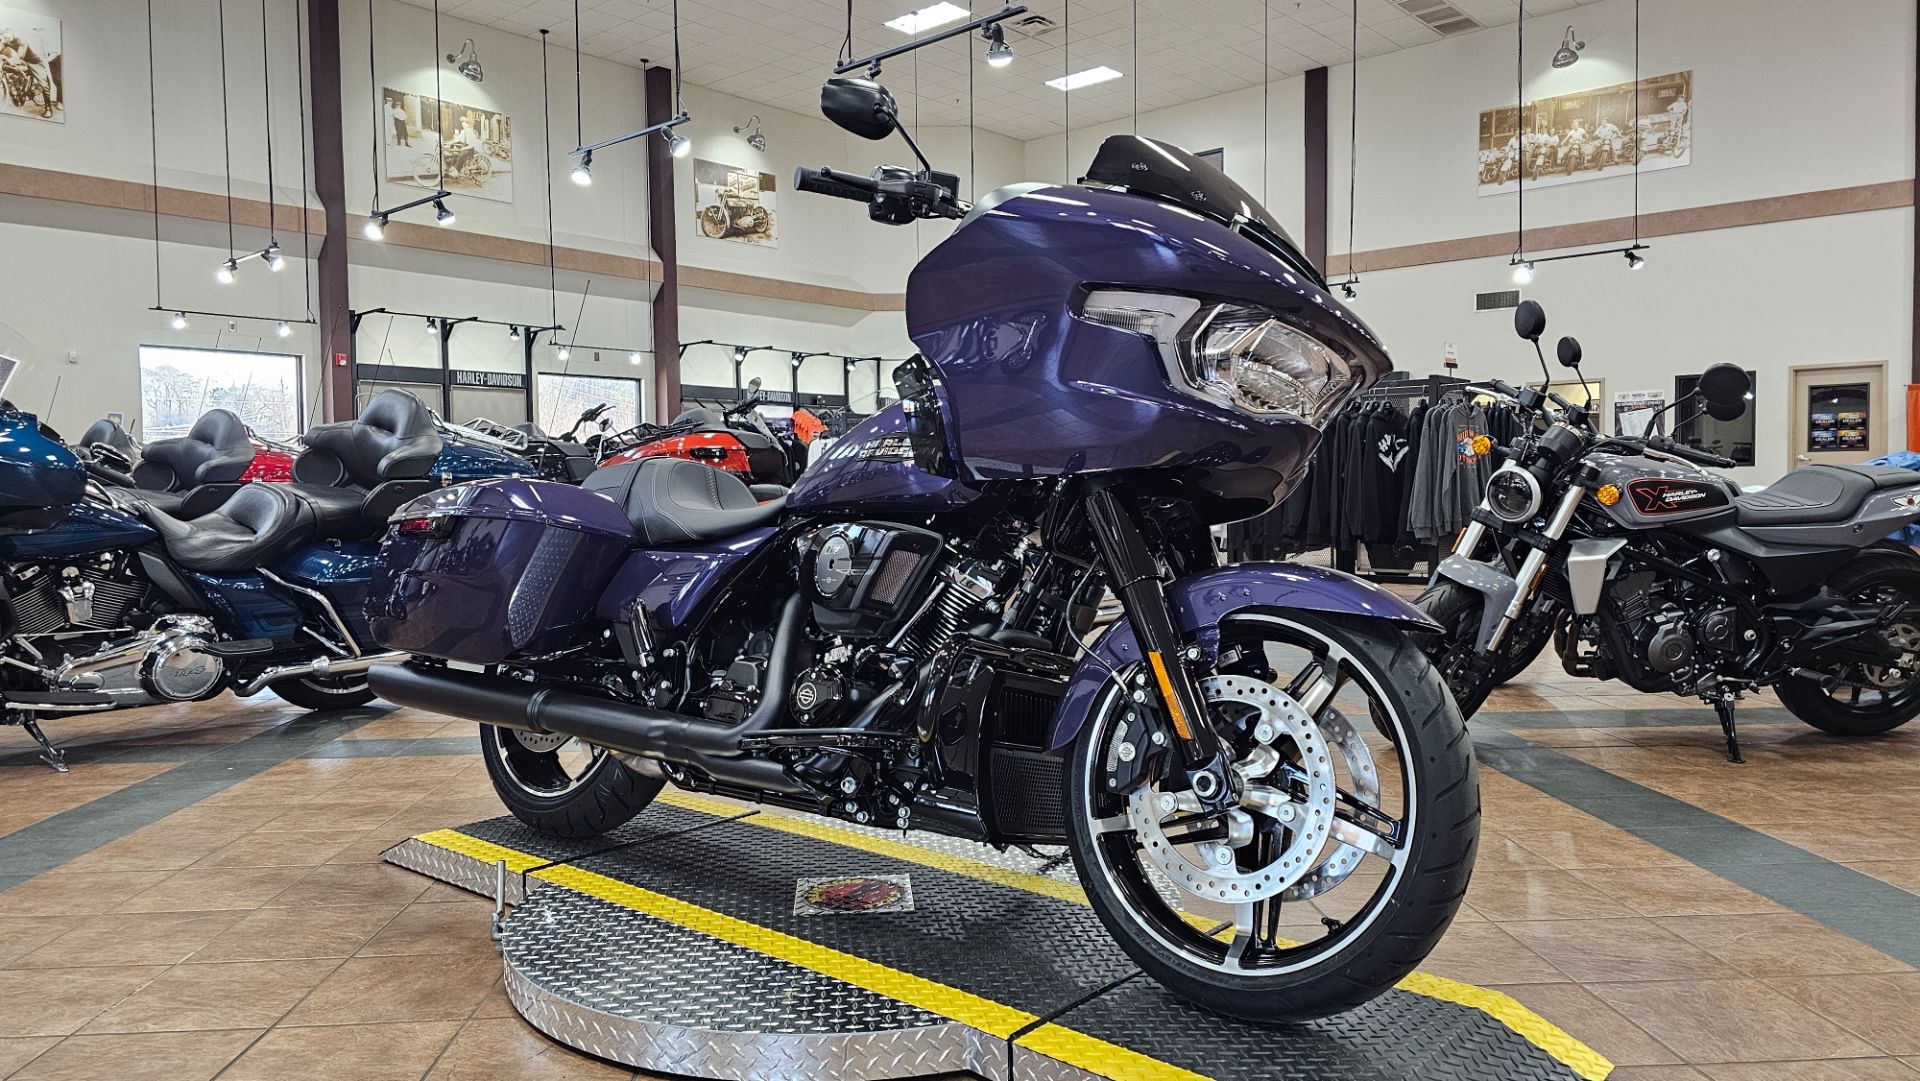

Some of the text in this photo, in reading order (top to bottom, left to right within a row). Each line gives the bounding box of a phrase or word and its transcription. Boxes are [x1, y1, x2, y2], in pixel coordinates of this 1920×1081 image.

[456, 371, 522, 387] HARLEY-DAVIDSON
[746, 390, 792, 402] HEY-DAVIDSON
[1664, 493, 1706, 502] DAVIDSON
